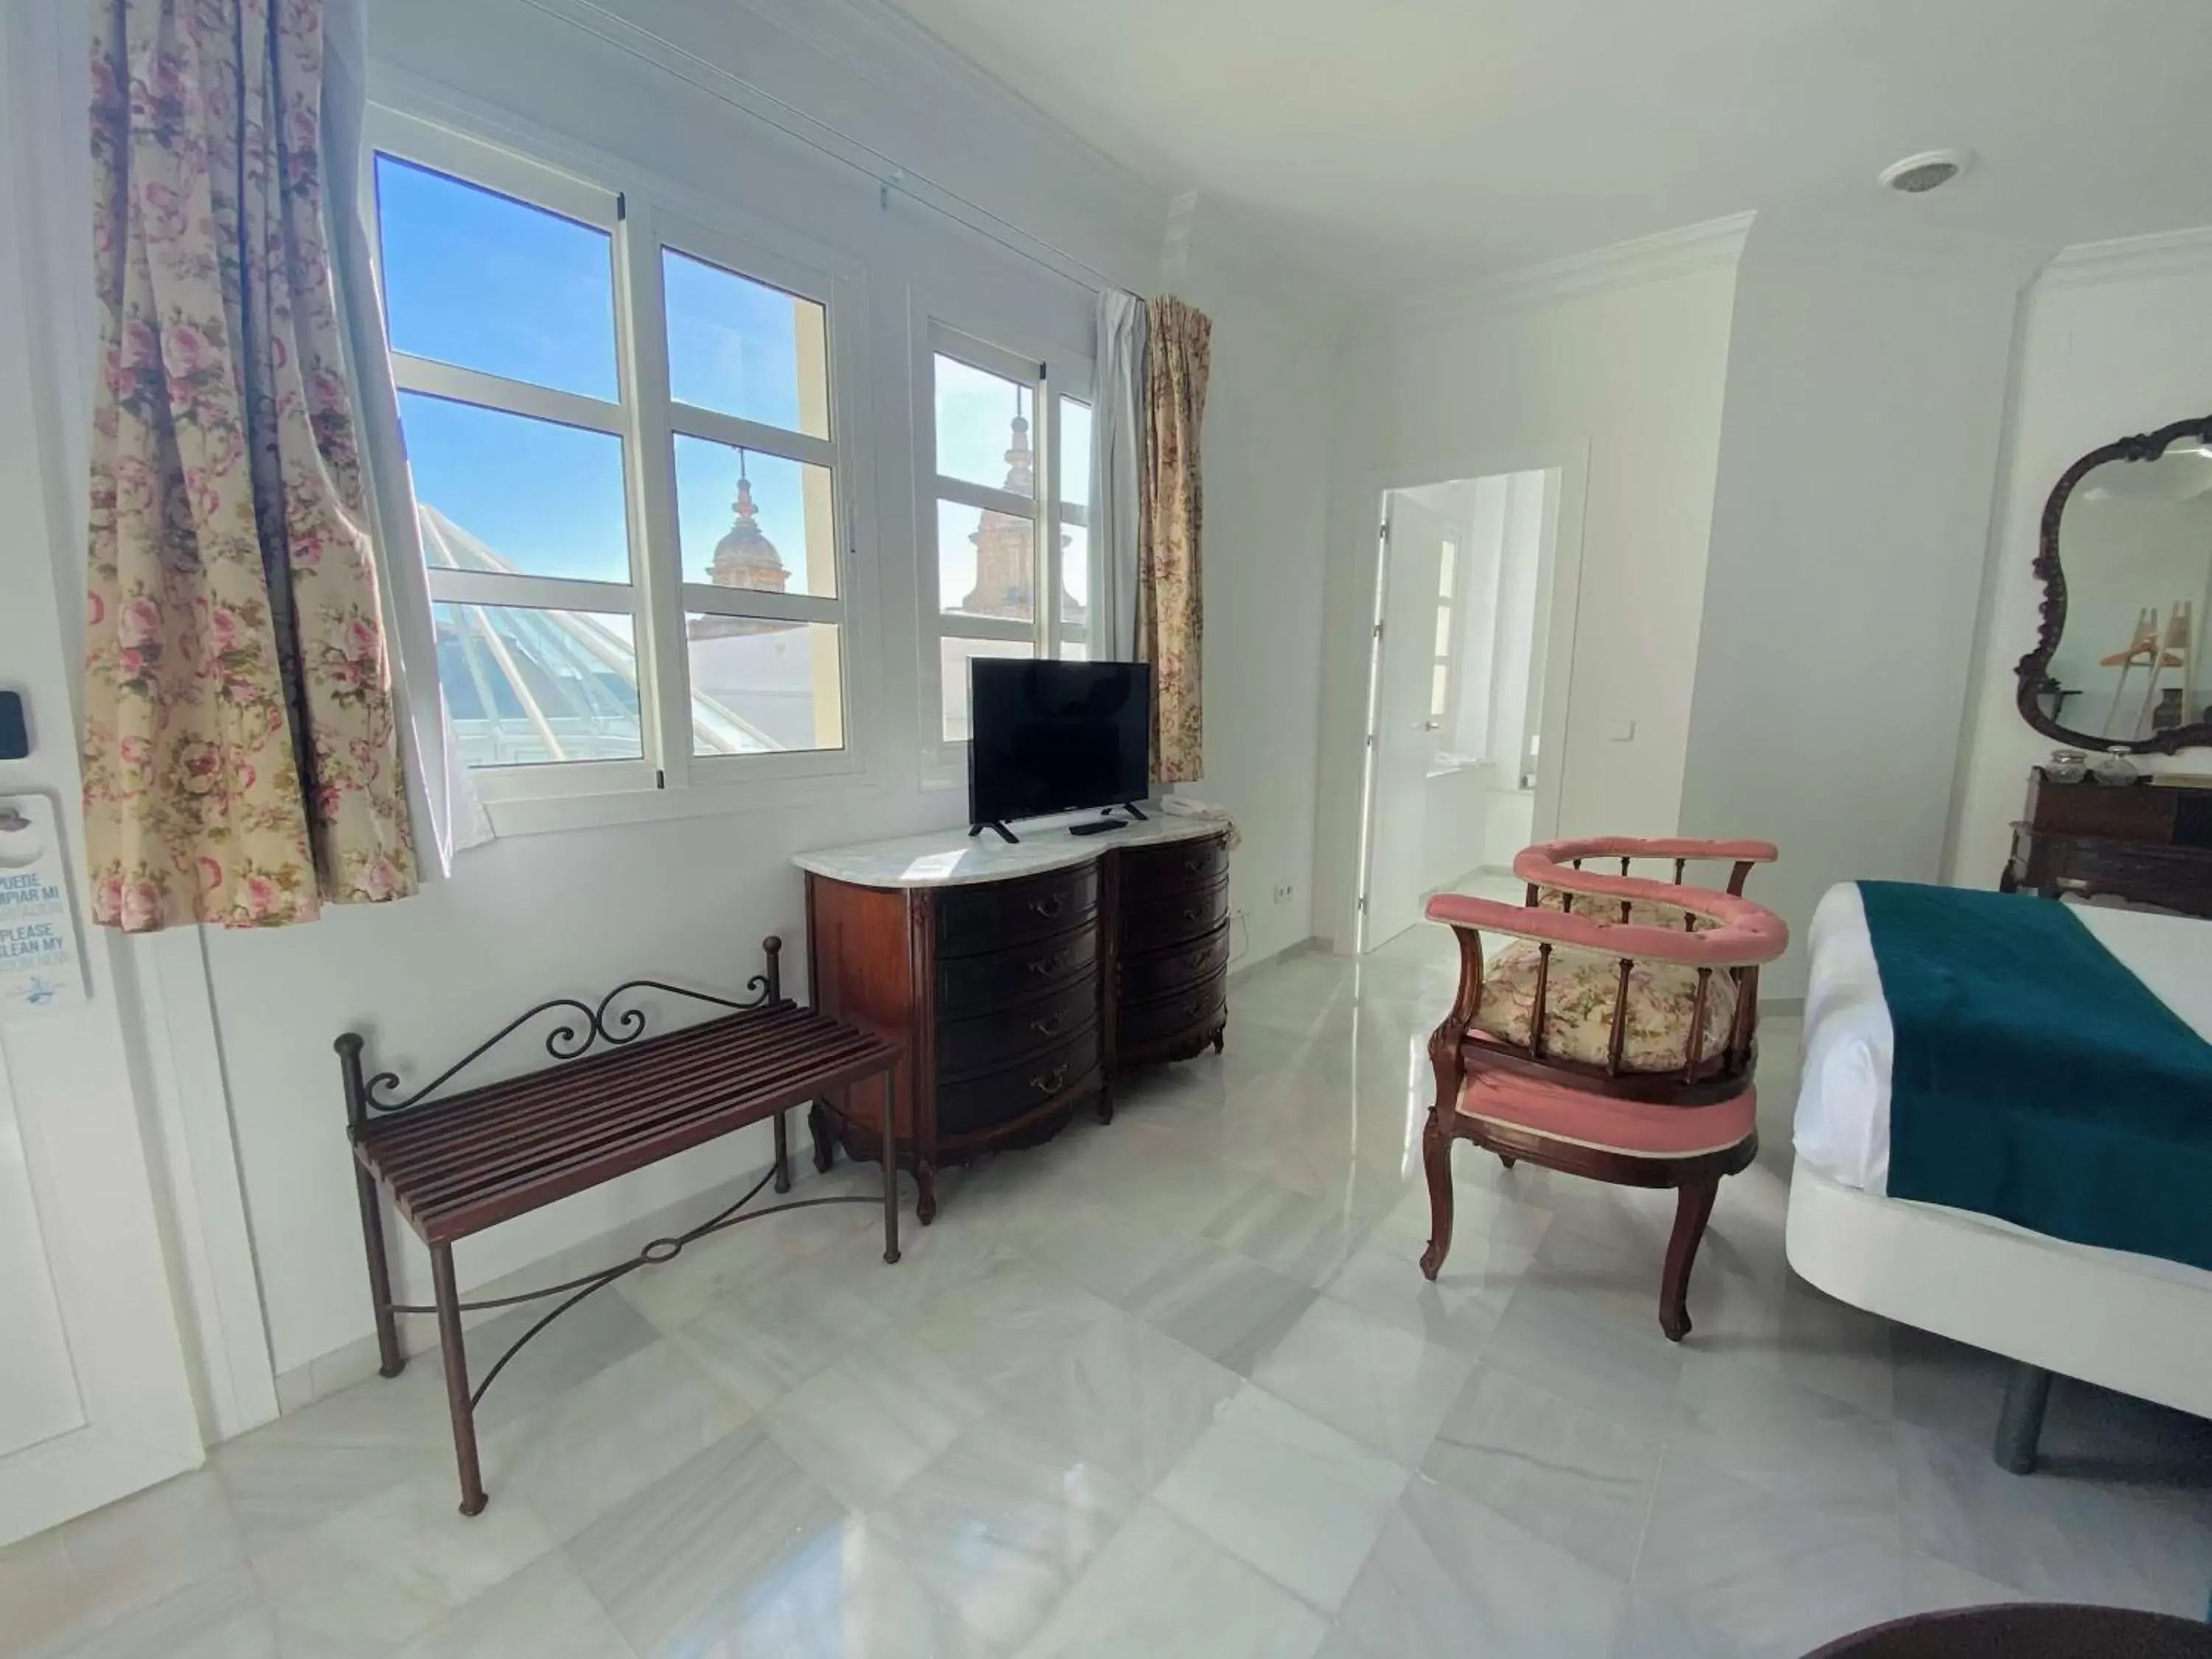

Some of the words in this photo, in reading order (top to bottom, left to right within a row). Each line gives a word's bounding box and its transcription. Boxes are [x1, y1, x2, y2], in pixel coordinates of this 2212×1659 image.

[43, 886, 60, 901] MI
[0, 922, 54, 943] PLEASE
[43, 936, 63, 951] MY
